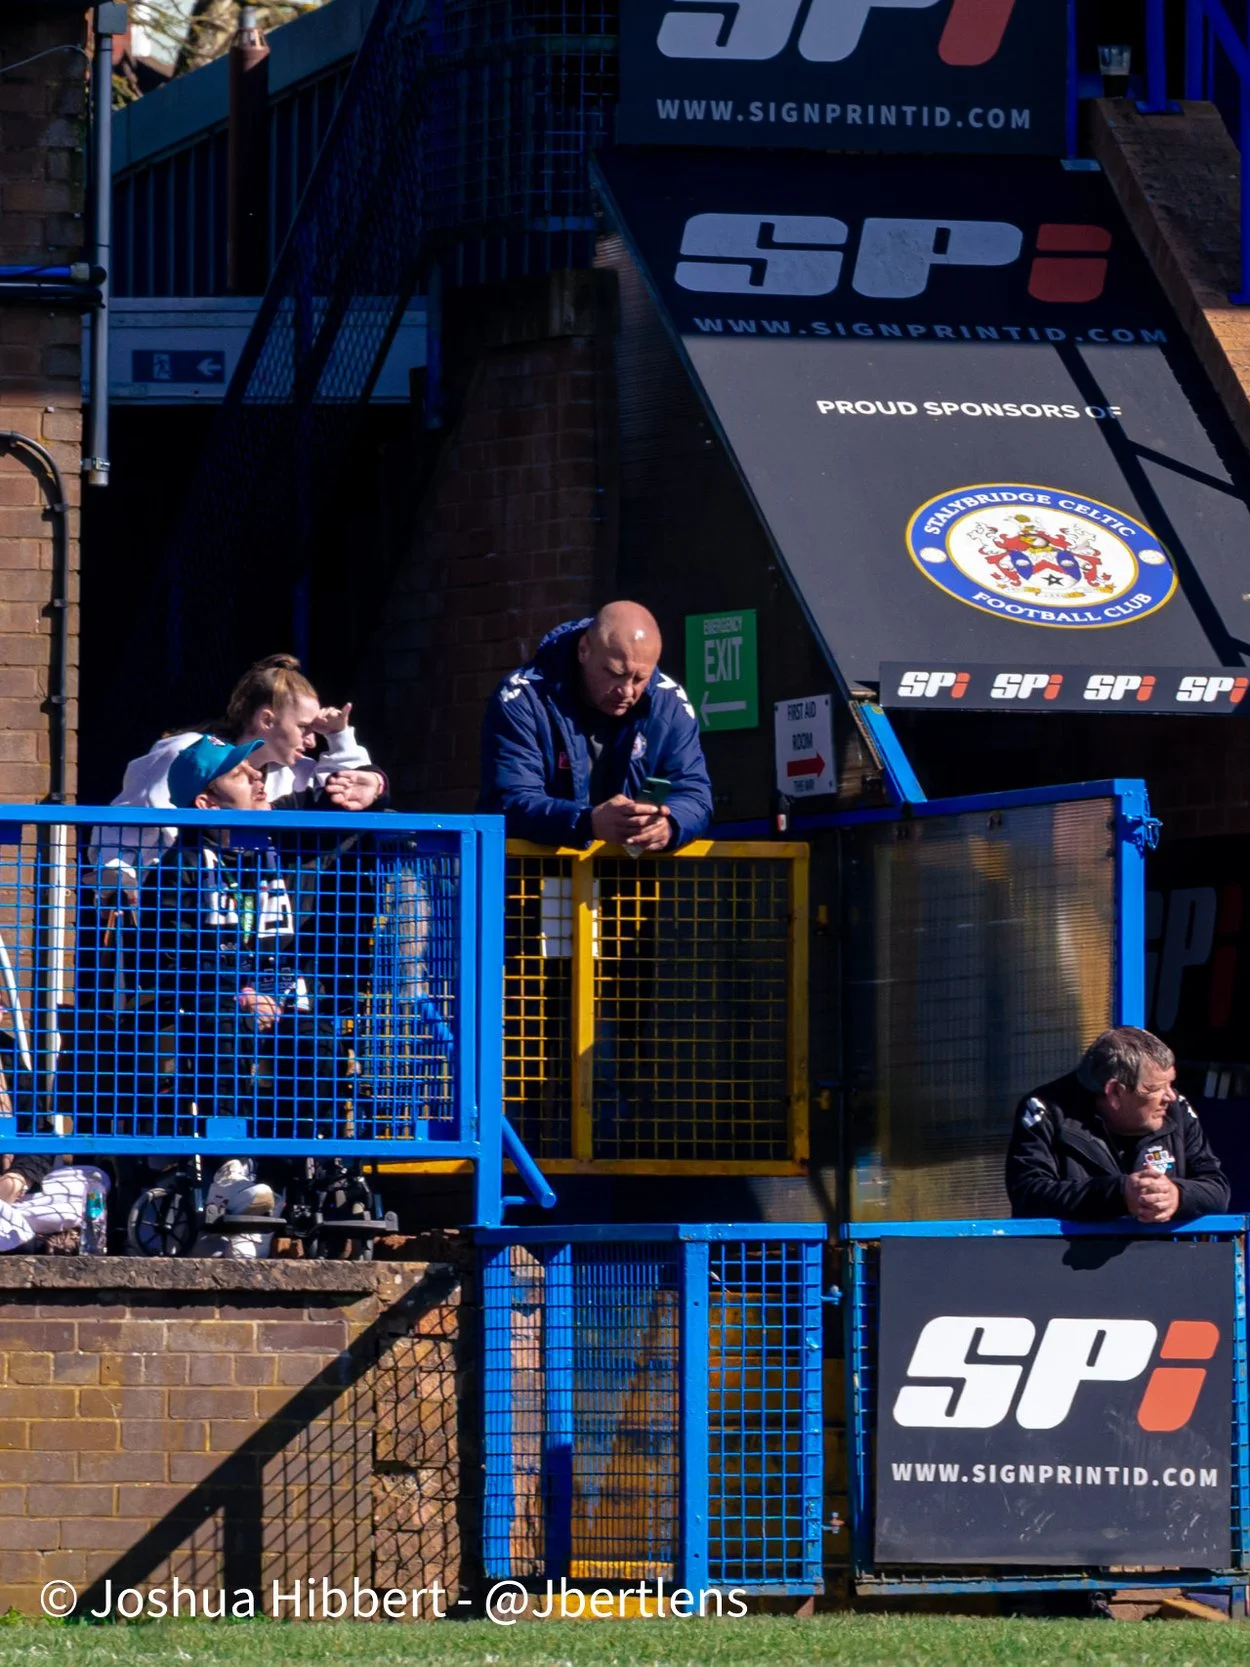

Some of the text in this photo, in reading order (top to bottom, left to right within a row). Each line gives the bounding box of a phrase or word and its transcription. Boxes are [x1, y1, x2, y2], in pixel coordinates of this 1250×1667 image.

[656, 98, 1031, 130] WWW.SIGNPRINTID.COM
[693, 316, 1169, 344] WWW.SIGNPRINTID.COM
[816, 399, 1122, 420] PROUD SPONSORS OF
[924, 491, 1136, 538] STALYBRIDGE CELTIC
[971, 591, 1152, 622] FOOTBALL CLUB
[704, 637, 743, 683] EXIT
[787, 700, 817, 721] FIRST AID
[792, 732, 814, 751] ROOM
[891, 1462, 1218, 1488] WWW.SIGNPRINTID.COM
